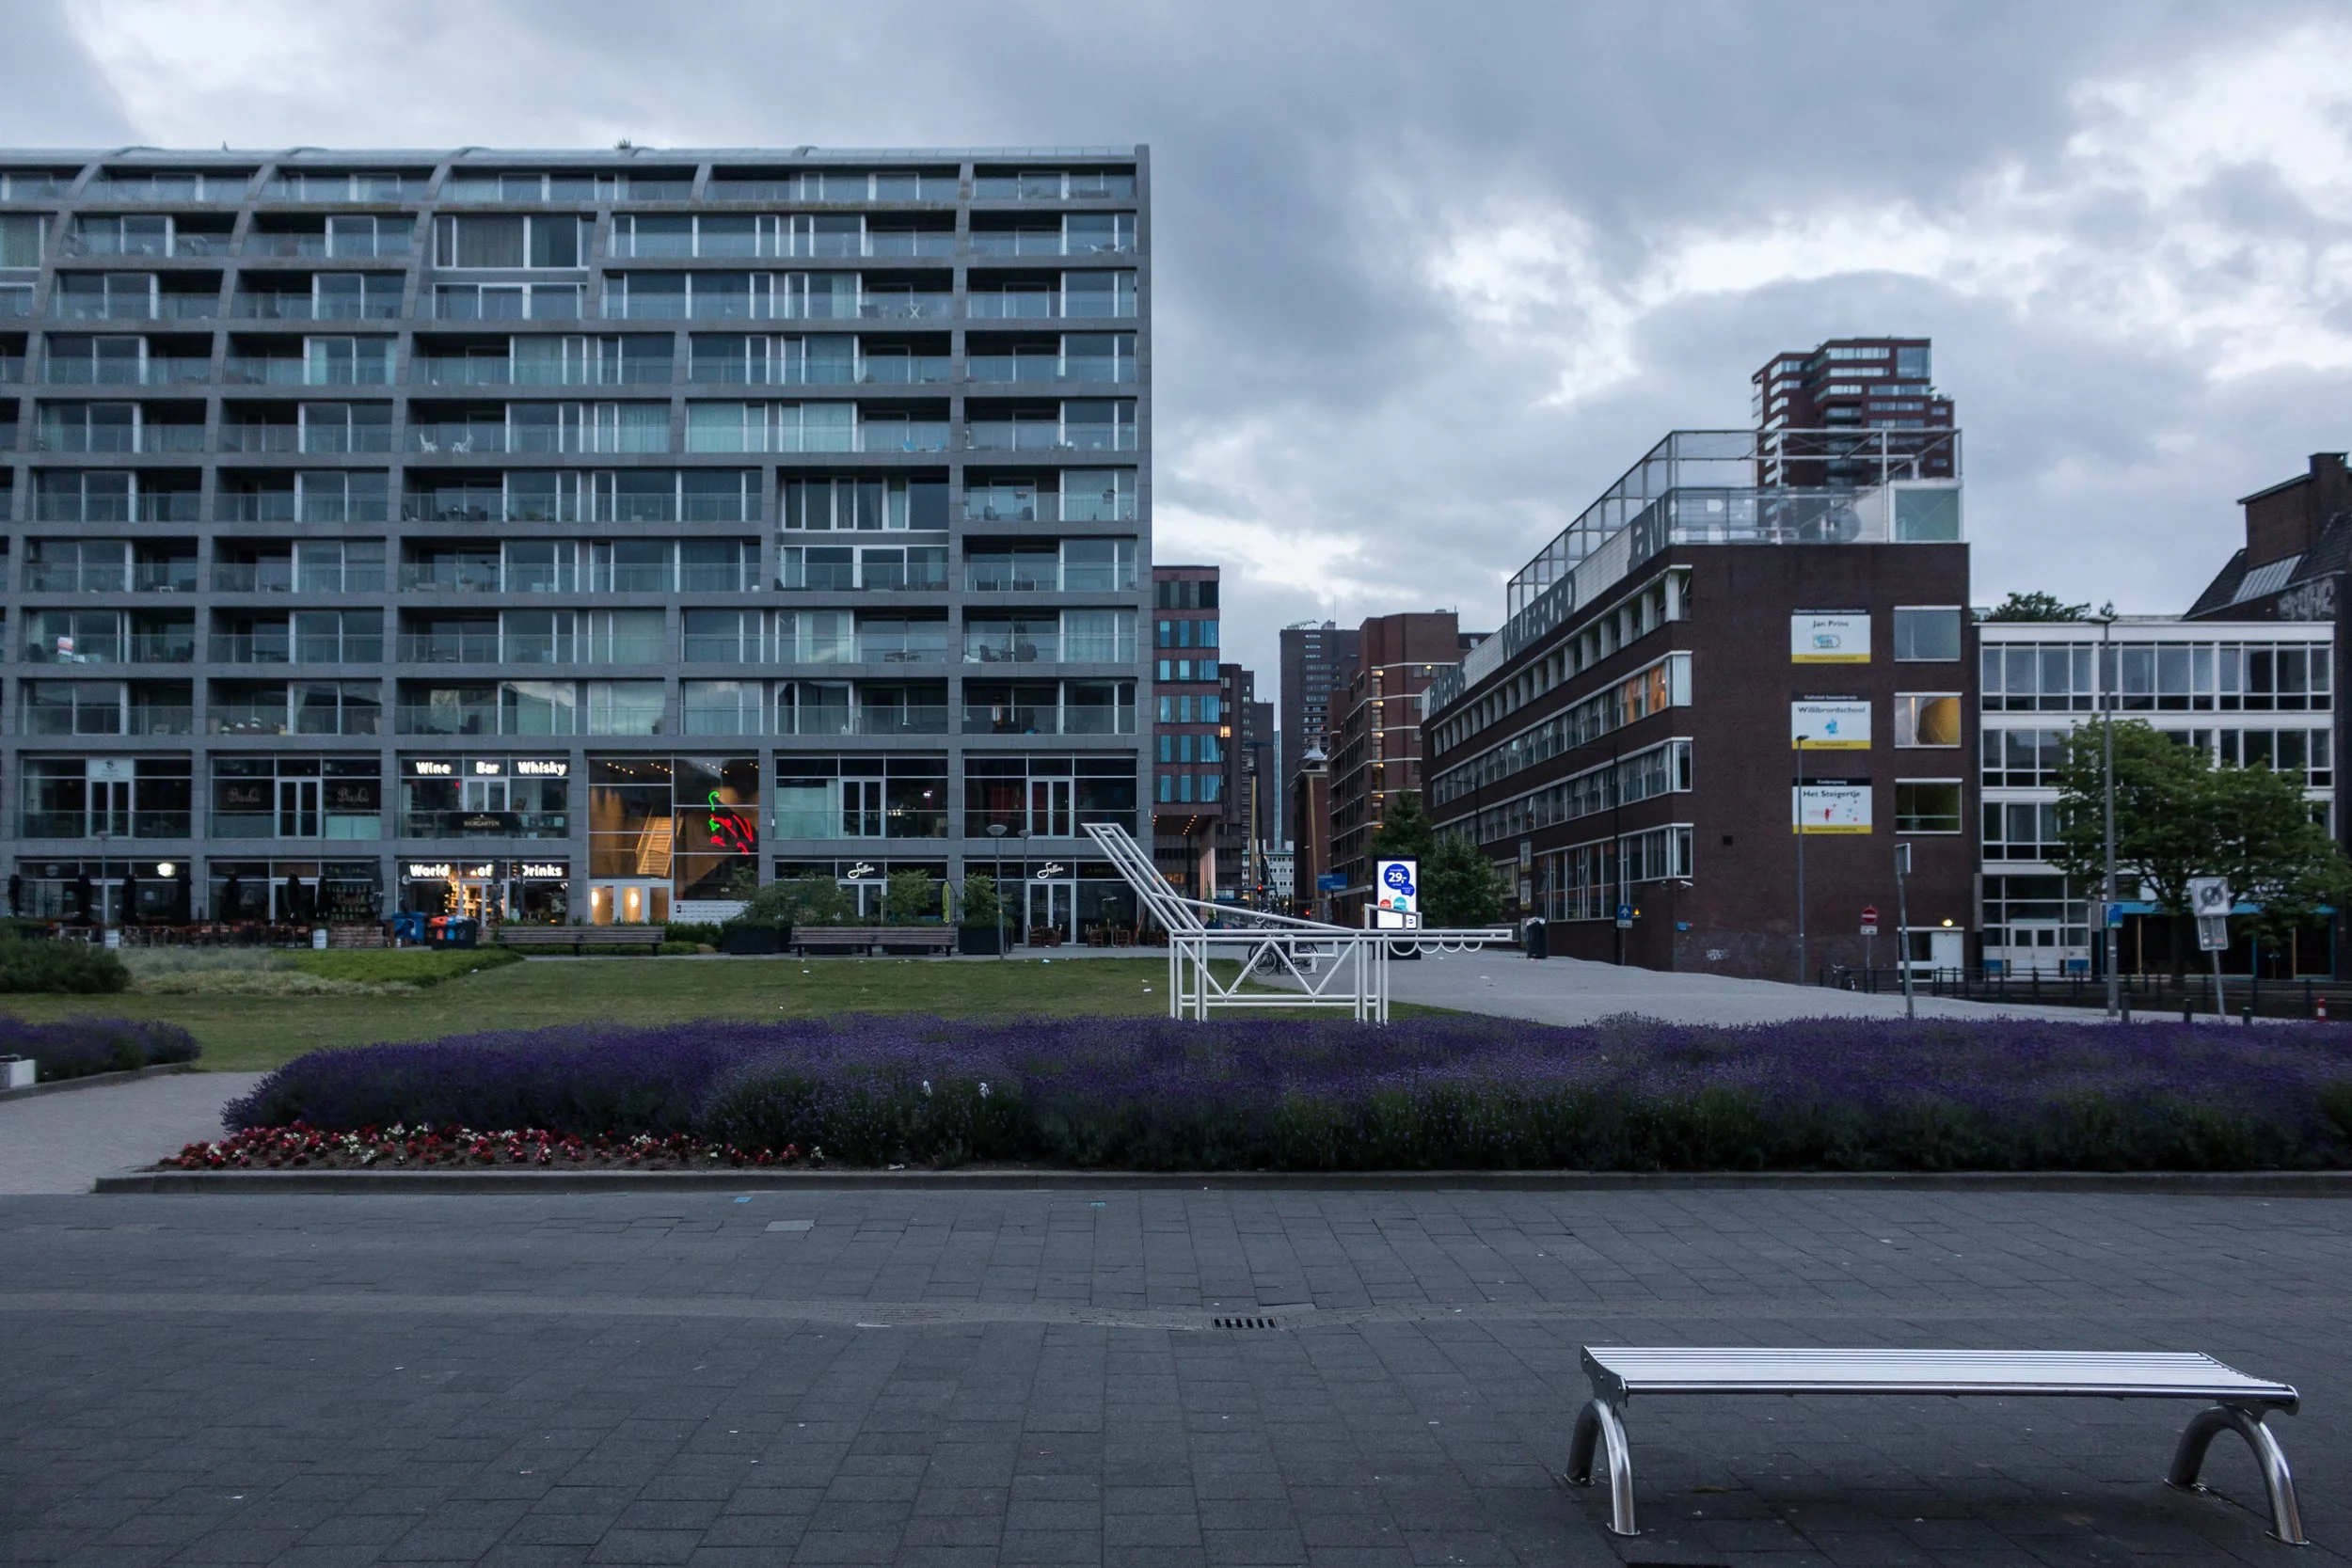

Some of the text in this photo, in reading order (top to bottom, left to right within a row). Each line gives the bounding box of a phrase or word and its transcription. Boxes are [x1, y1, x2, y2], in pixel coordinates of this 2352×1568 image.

[1813, 620, 1826, 628] Jan
[416, 761, 566, 776] Wine Bar Whisky
[1820, 790, 1861, 799] Steigertje
[409, 863, 451, 877] World
[478, 864, 494, 877] of
